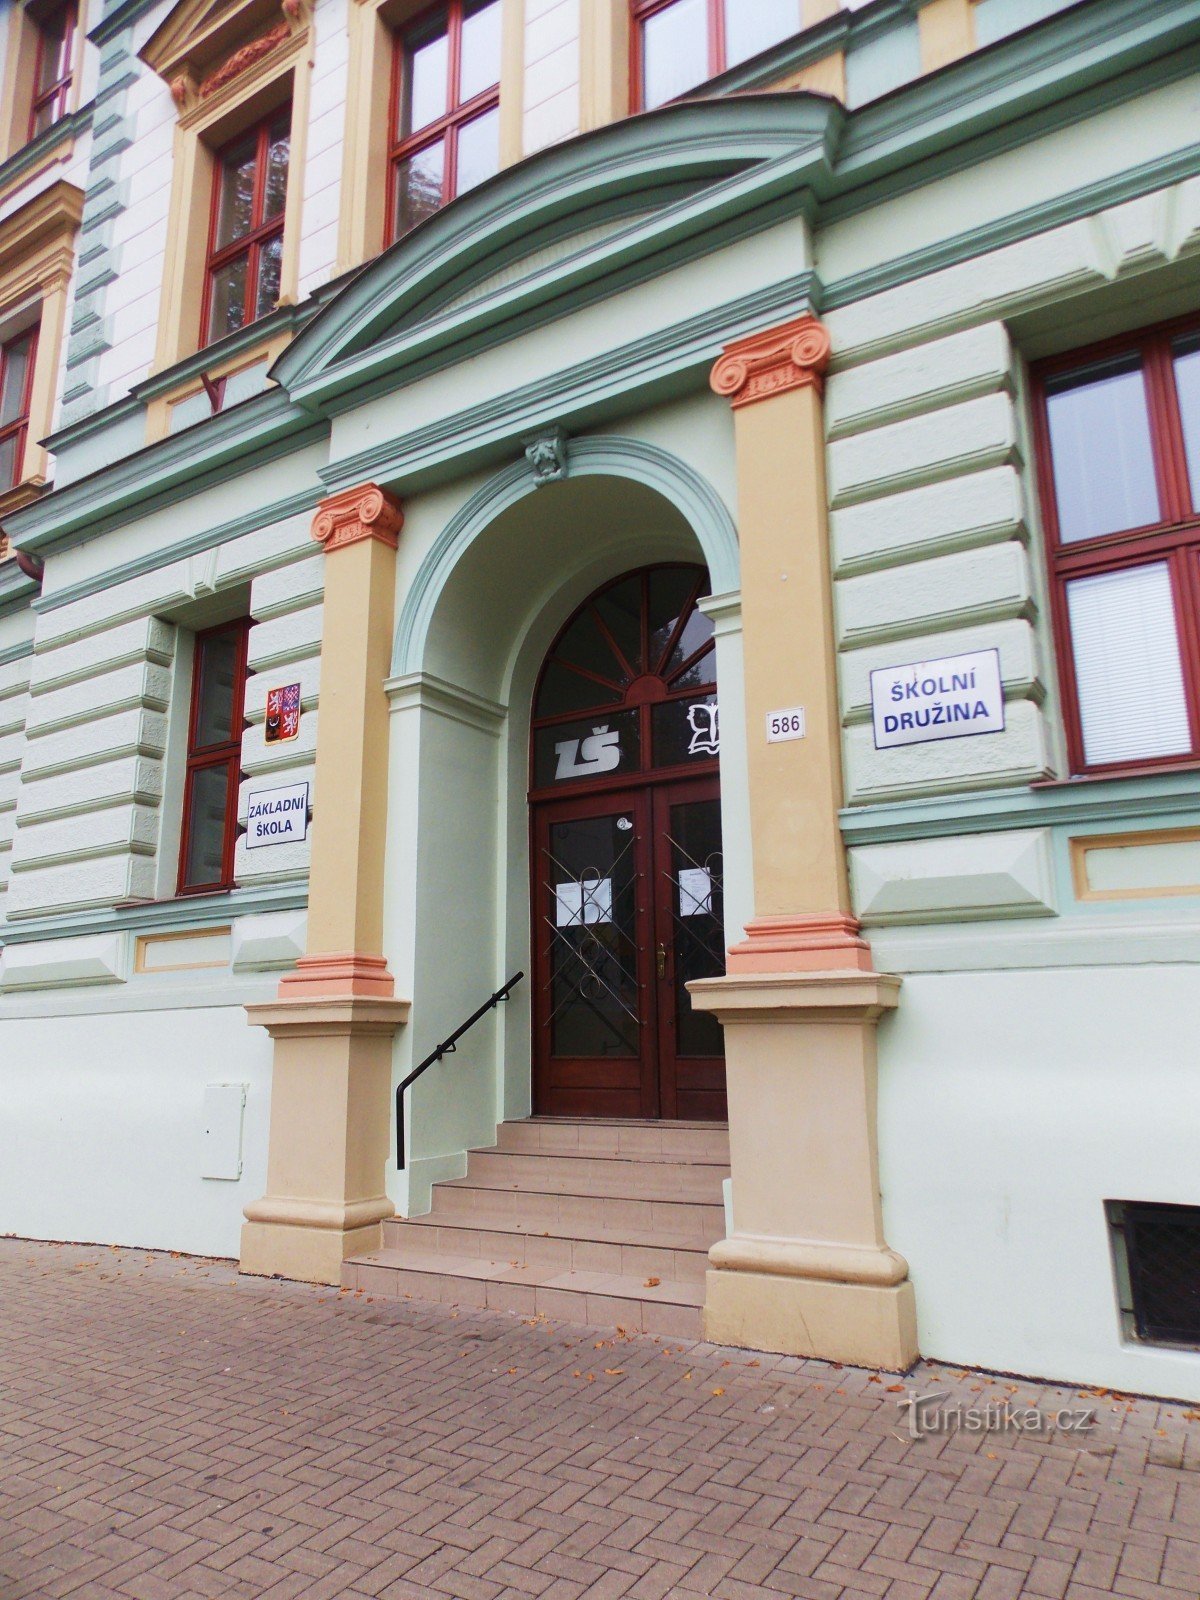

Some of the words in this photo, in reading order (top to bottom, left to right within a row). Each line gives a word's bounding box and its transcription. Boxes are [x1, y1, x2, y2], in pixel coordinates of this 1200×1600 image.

[890, 667, 976, 702] ŠKOLNÍ
[771, 715, 800, 735] 586
[883, 700, 990, 733] DRUŽINA
[555, 724, 621, 780] ZŠ
[249, 794, 306, 818] ZÁKLADNÍ
[256, 819, 293, 837] ŠKOLA
